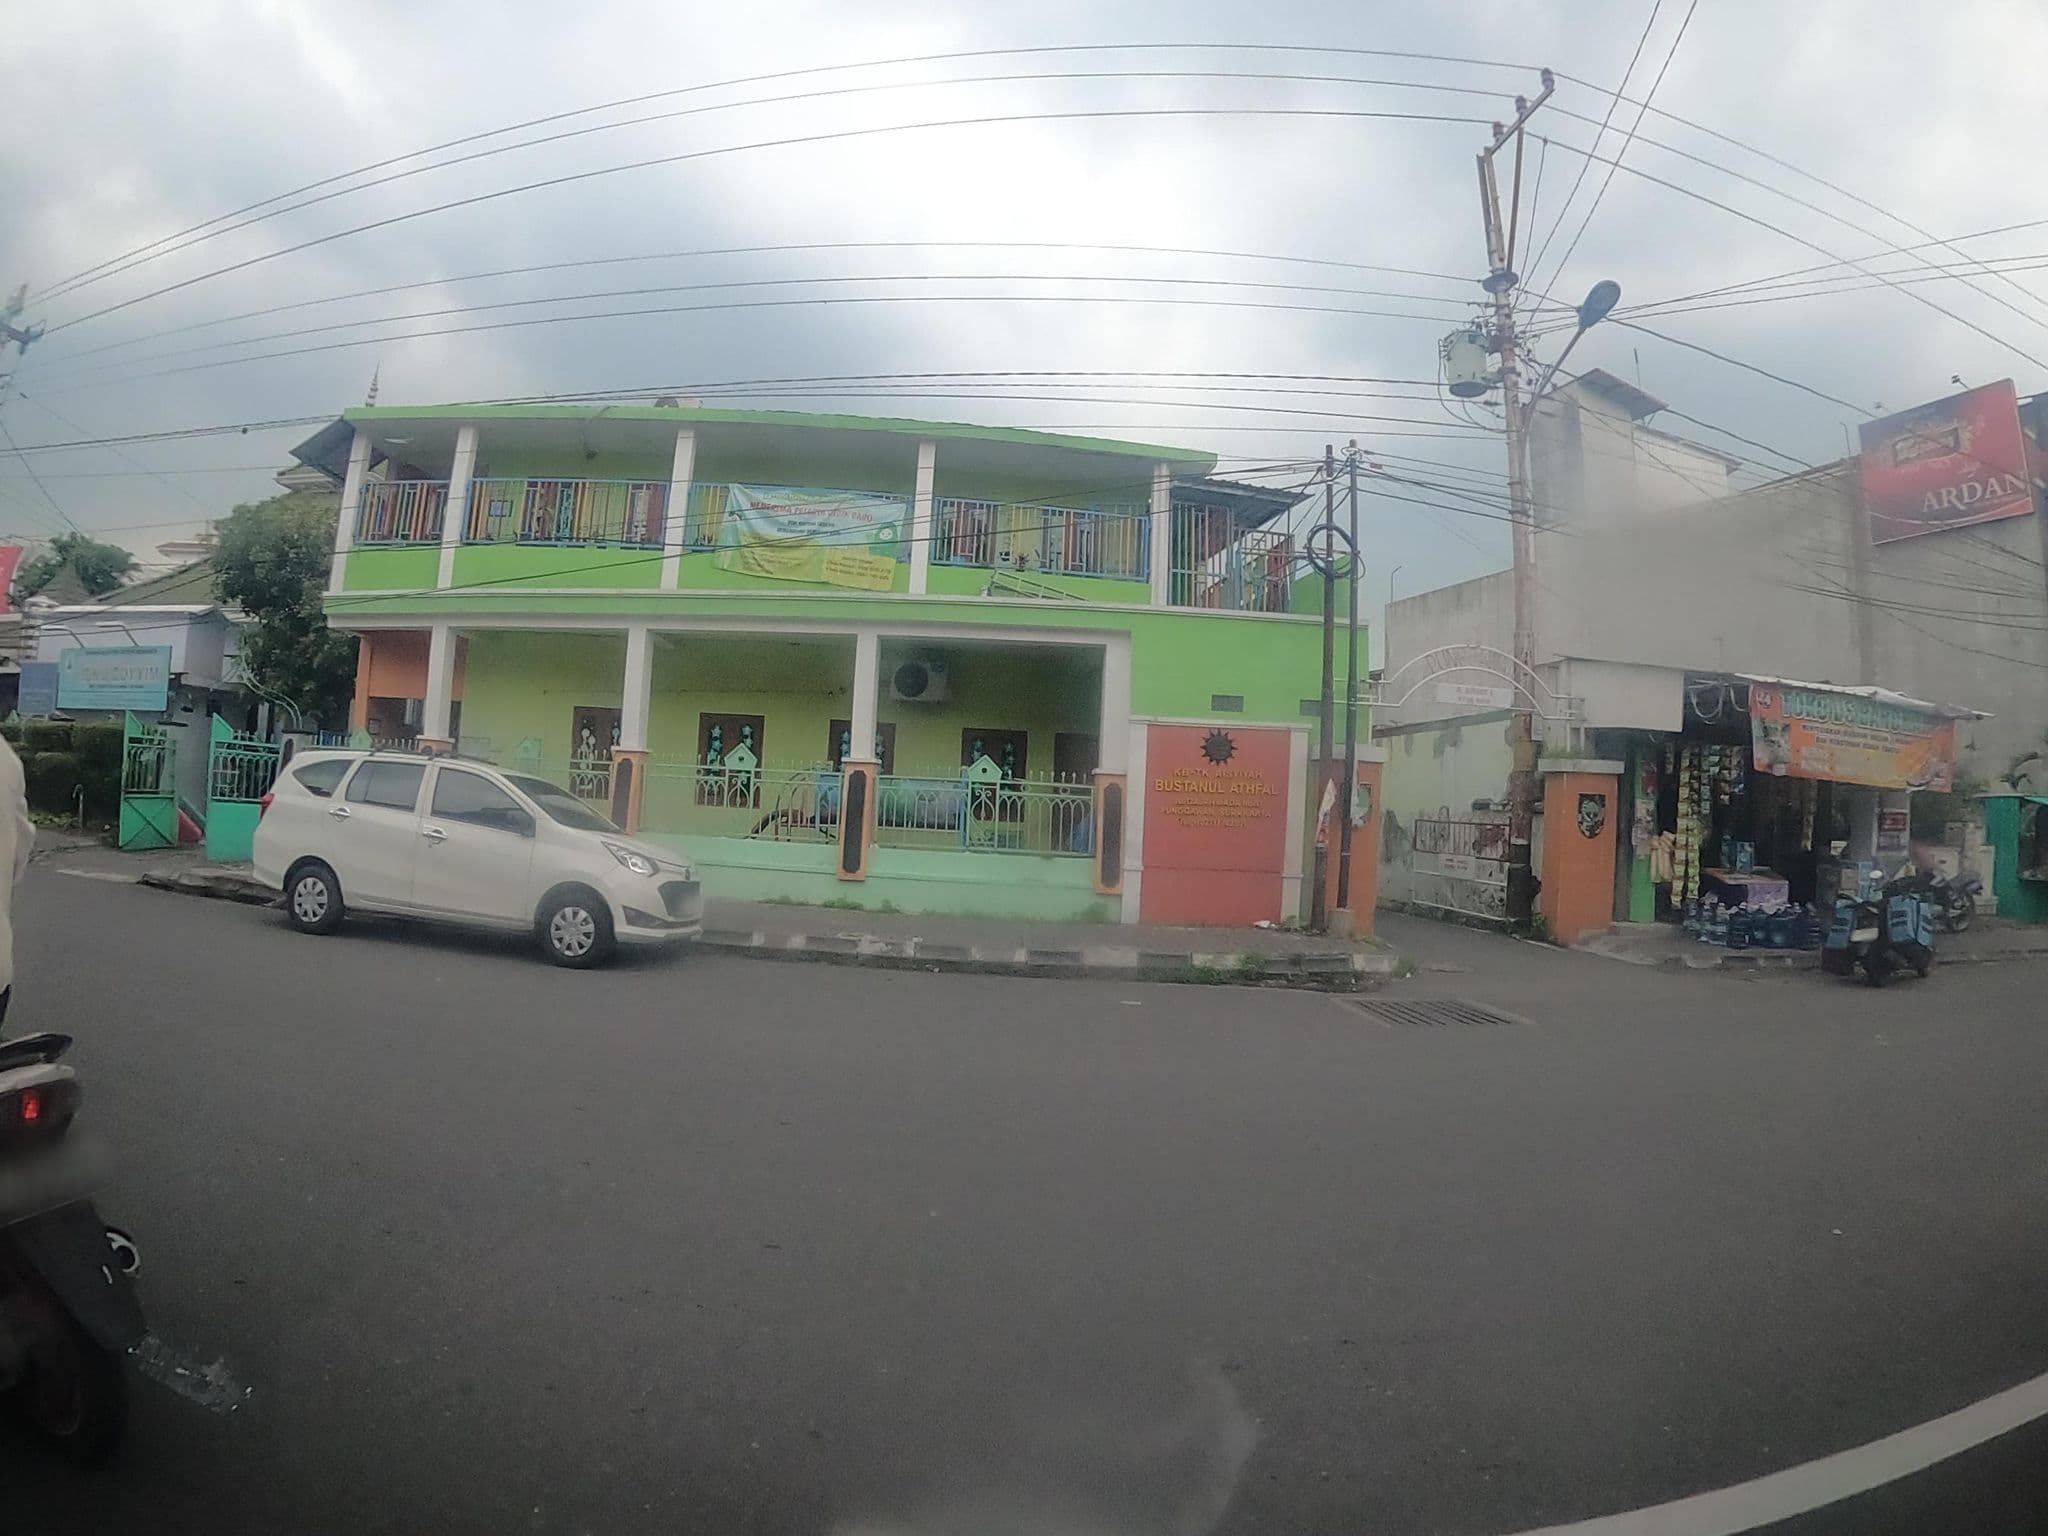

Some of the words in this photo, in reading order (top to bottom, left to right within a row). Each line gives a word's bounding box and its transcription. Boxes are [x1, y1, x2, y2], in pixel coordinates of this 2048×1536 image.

[1922, 472, 2029, 512] ARDAN
[1155, 779, 1226, 794] BUSTANUL
[1229, 783, 1278, 796] ATHFAL
